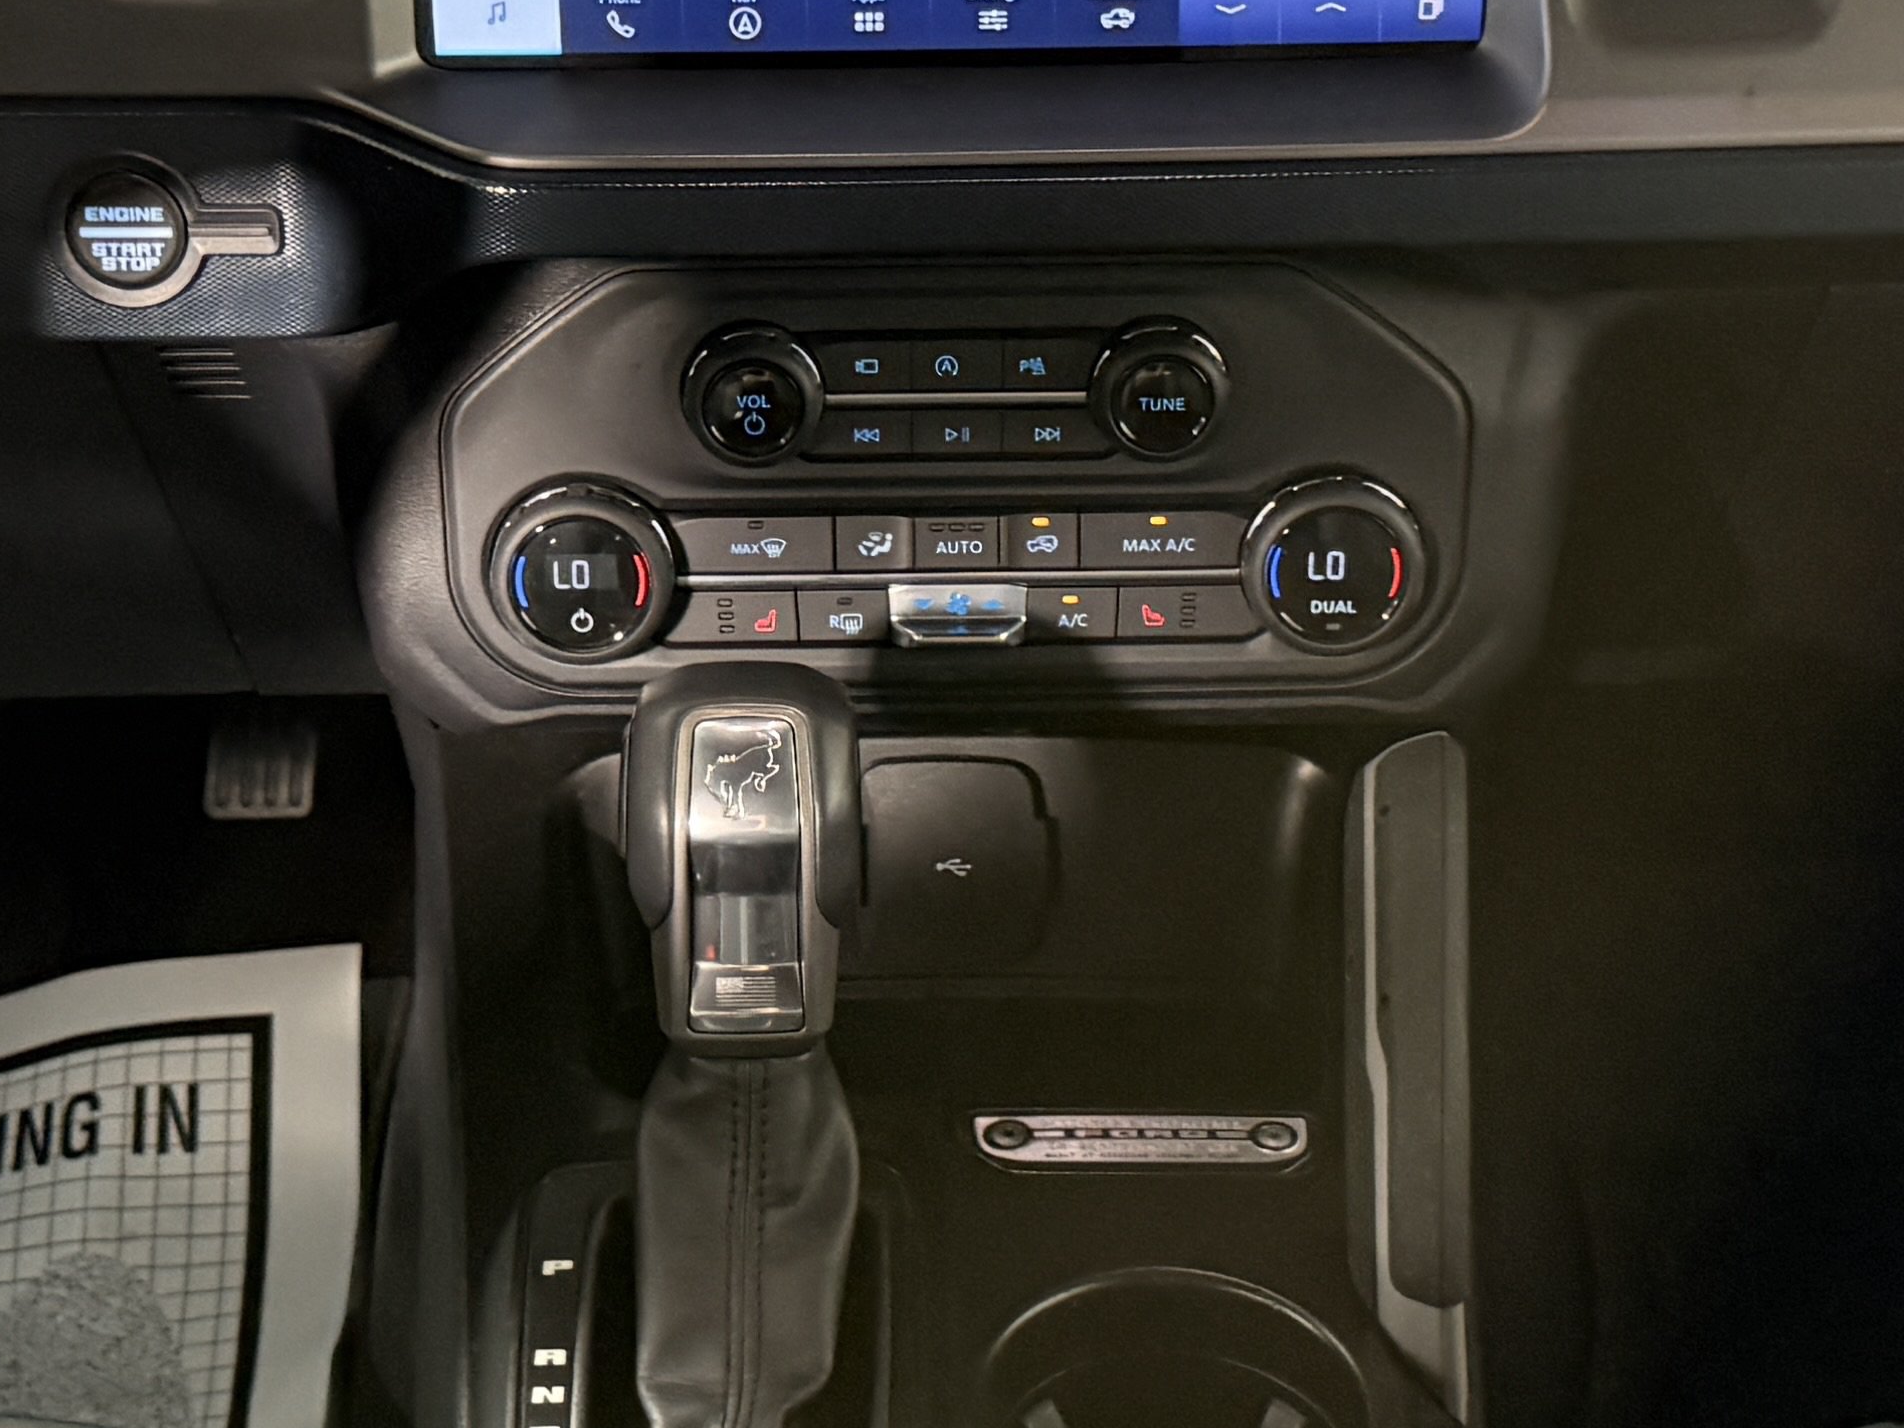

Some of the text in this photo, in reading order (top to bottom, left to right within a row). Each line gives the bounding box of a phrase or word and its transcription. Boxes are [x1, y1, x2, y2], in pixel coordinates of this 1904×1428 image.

[84, 207, 164, 222] ENGINE
[91, 242, 165, 257] START
[101, 257, 160, 271] STOP
[736, 395, 771, 409] VOL
[1139, 397, 1186, 412] TUNE
[731, 543, 760, 555] MAX
[936, 541, 983, 554] AUTO
[1123, 538, 1196, 553] MAX A/C
[1307, 550, 1345, 581] LO
[553, 559, 589, 590] LO
[1310, 599, 1357, 614] DUAL
[829, 615, 839, 628] R
[1059, 613, 1088, 628] A/C
[131, 1082, 200, 1156] IN
[542, 1260, 574, 1276] P
[531, 1386, 565, 1404] N
